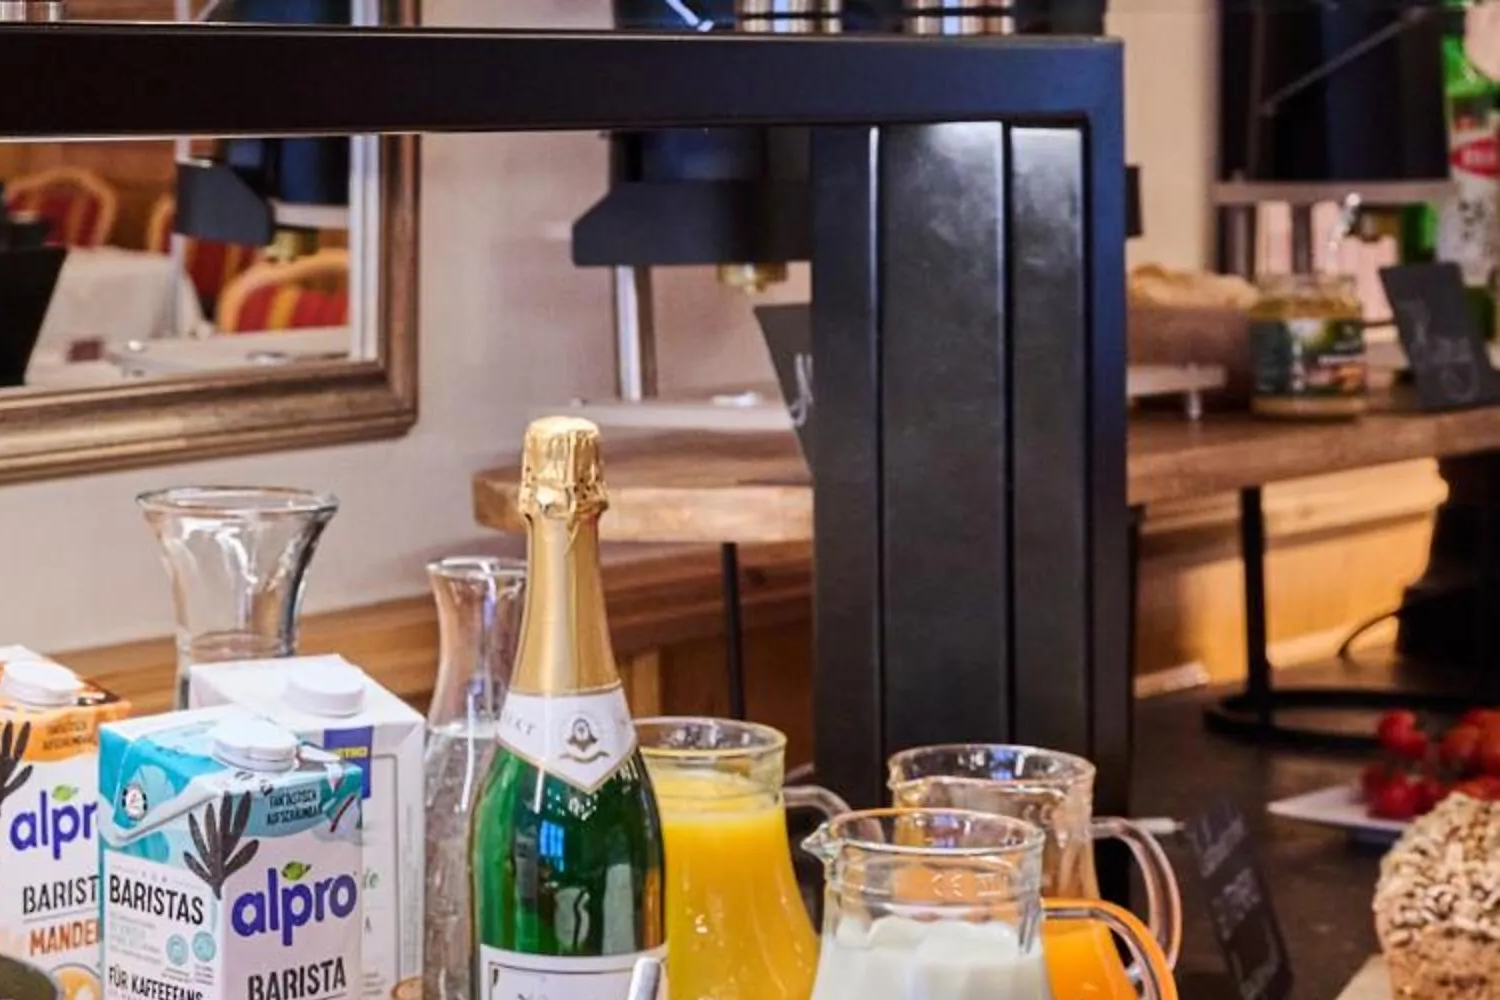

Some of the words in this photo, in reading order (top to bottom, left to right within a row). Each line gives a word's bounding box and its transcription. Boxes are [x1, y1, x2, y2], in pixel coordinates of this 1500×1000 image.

[10, 790, 98, 860] alpr
[23, 875, 99, 915] BARIST
[109, 874, 204, 925] BARISTAS
[232, 867, 357, 946] alpro
[109, 963, 128, 989] FÜR
